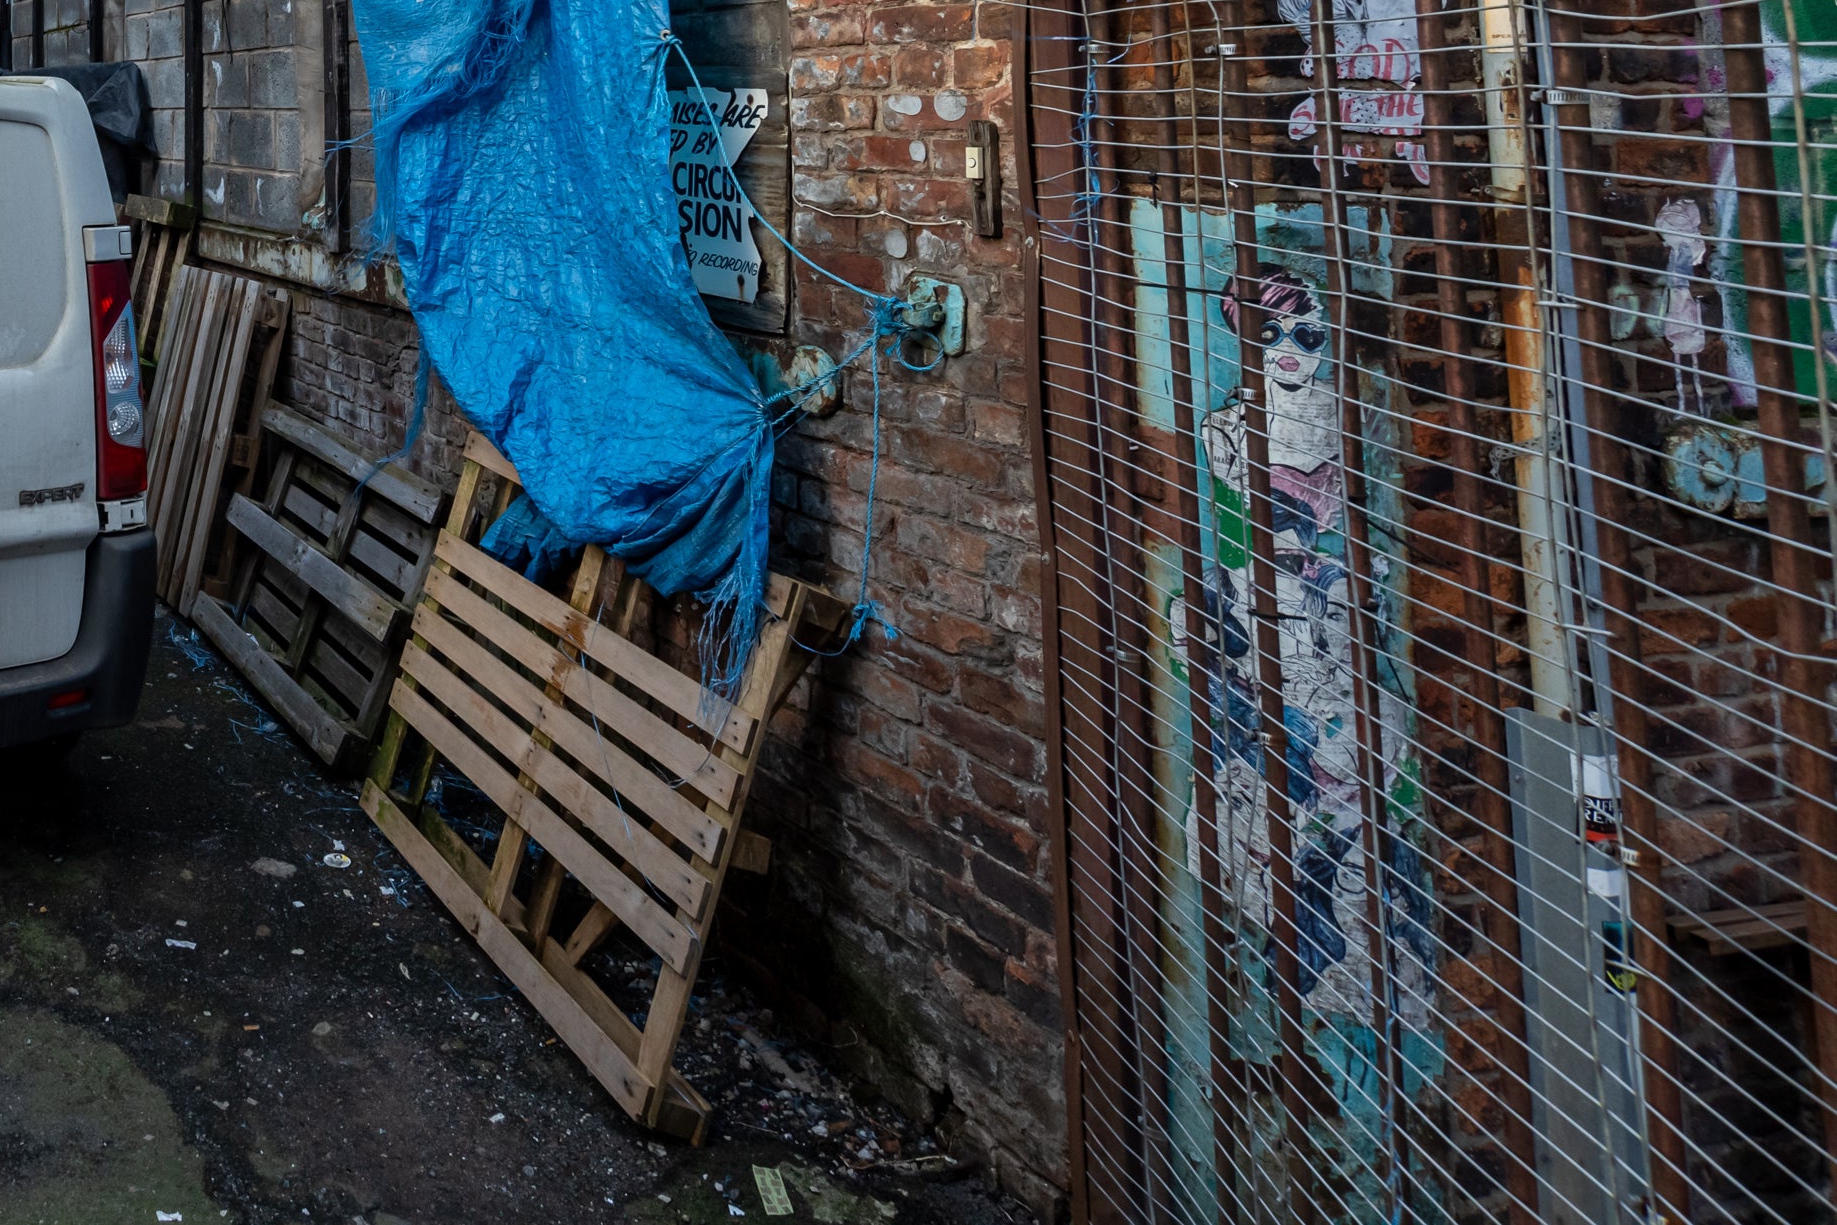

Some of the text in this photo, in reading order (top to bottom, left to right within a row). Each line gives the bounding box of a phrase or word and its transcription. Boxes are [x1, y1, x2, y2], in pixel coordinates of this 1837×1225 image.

[721, 104, 765, 128] ARE
[1366, 92, 1422, 118] THE
[691, 132, 722, 155] BY
[677, 199, 742, 243] SION
[698, 252, 758, 276] RECORDING
[19, 483, 84, 506] EXPERT
